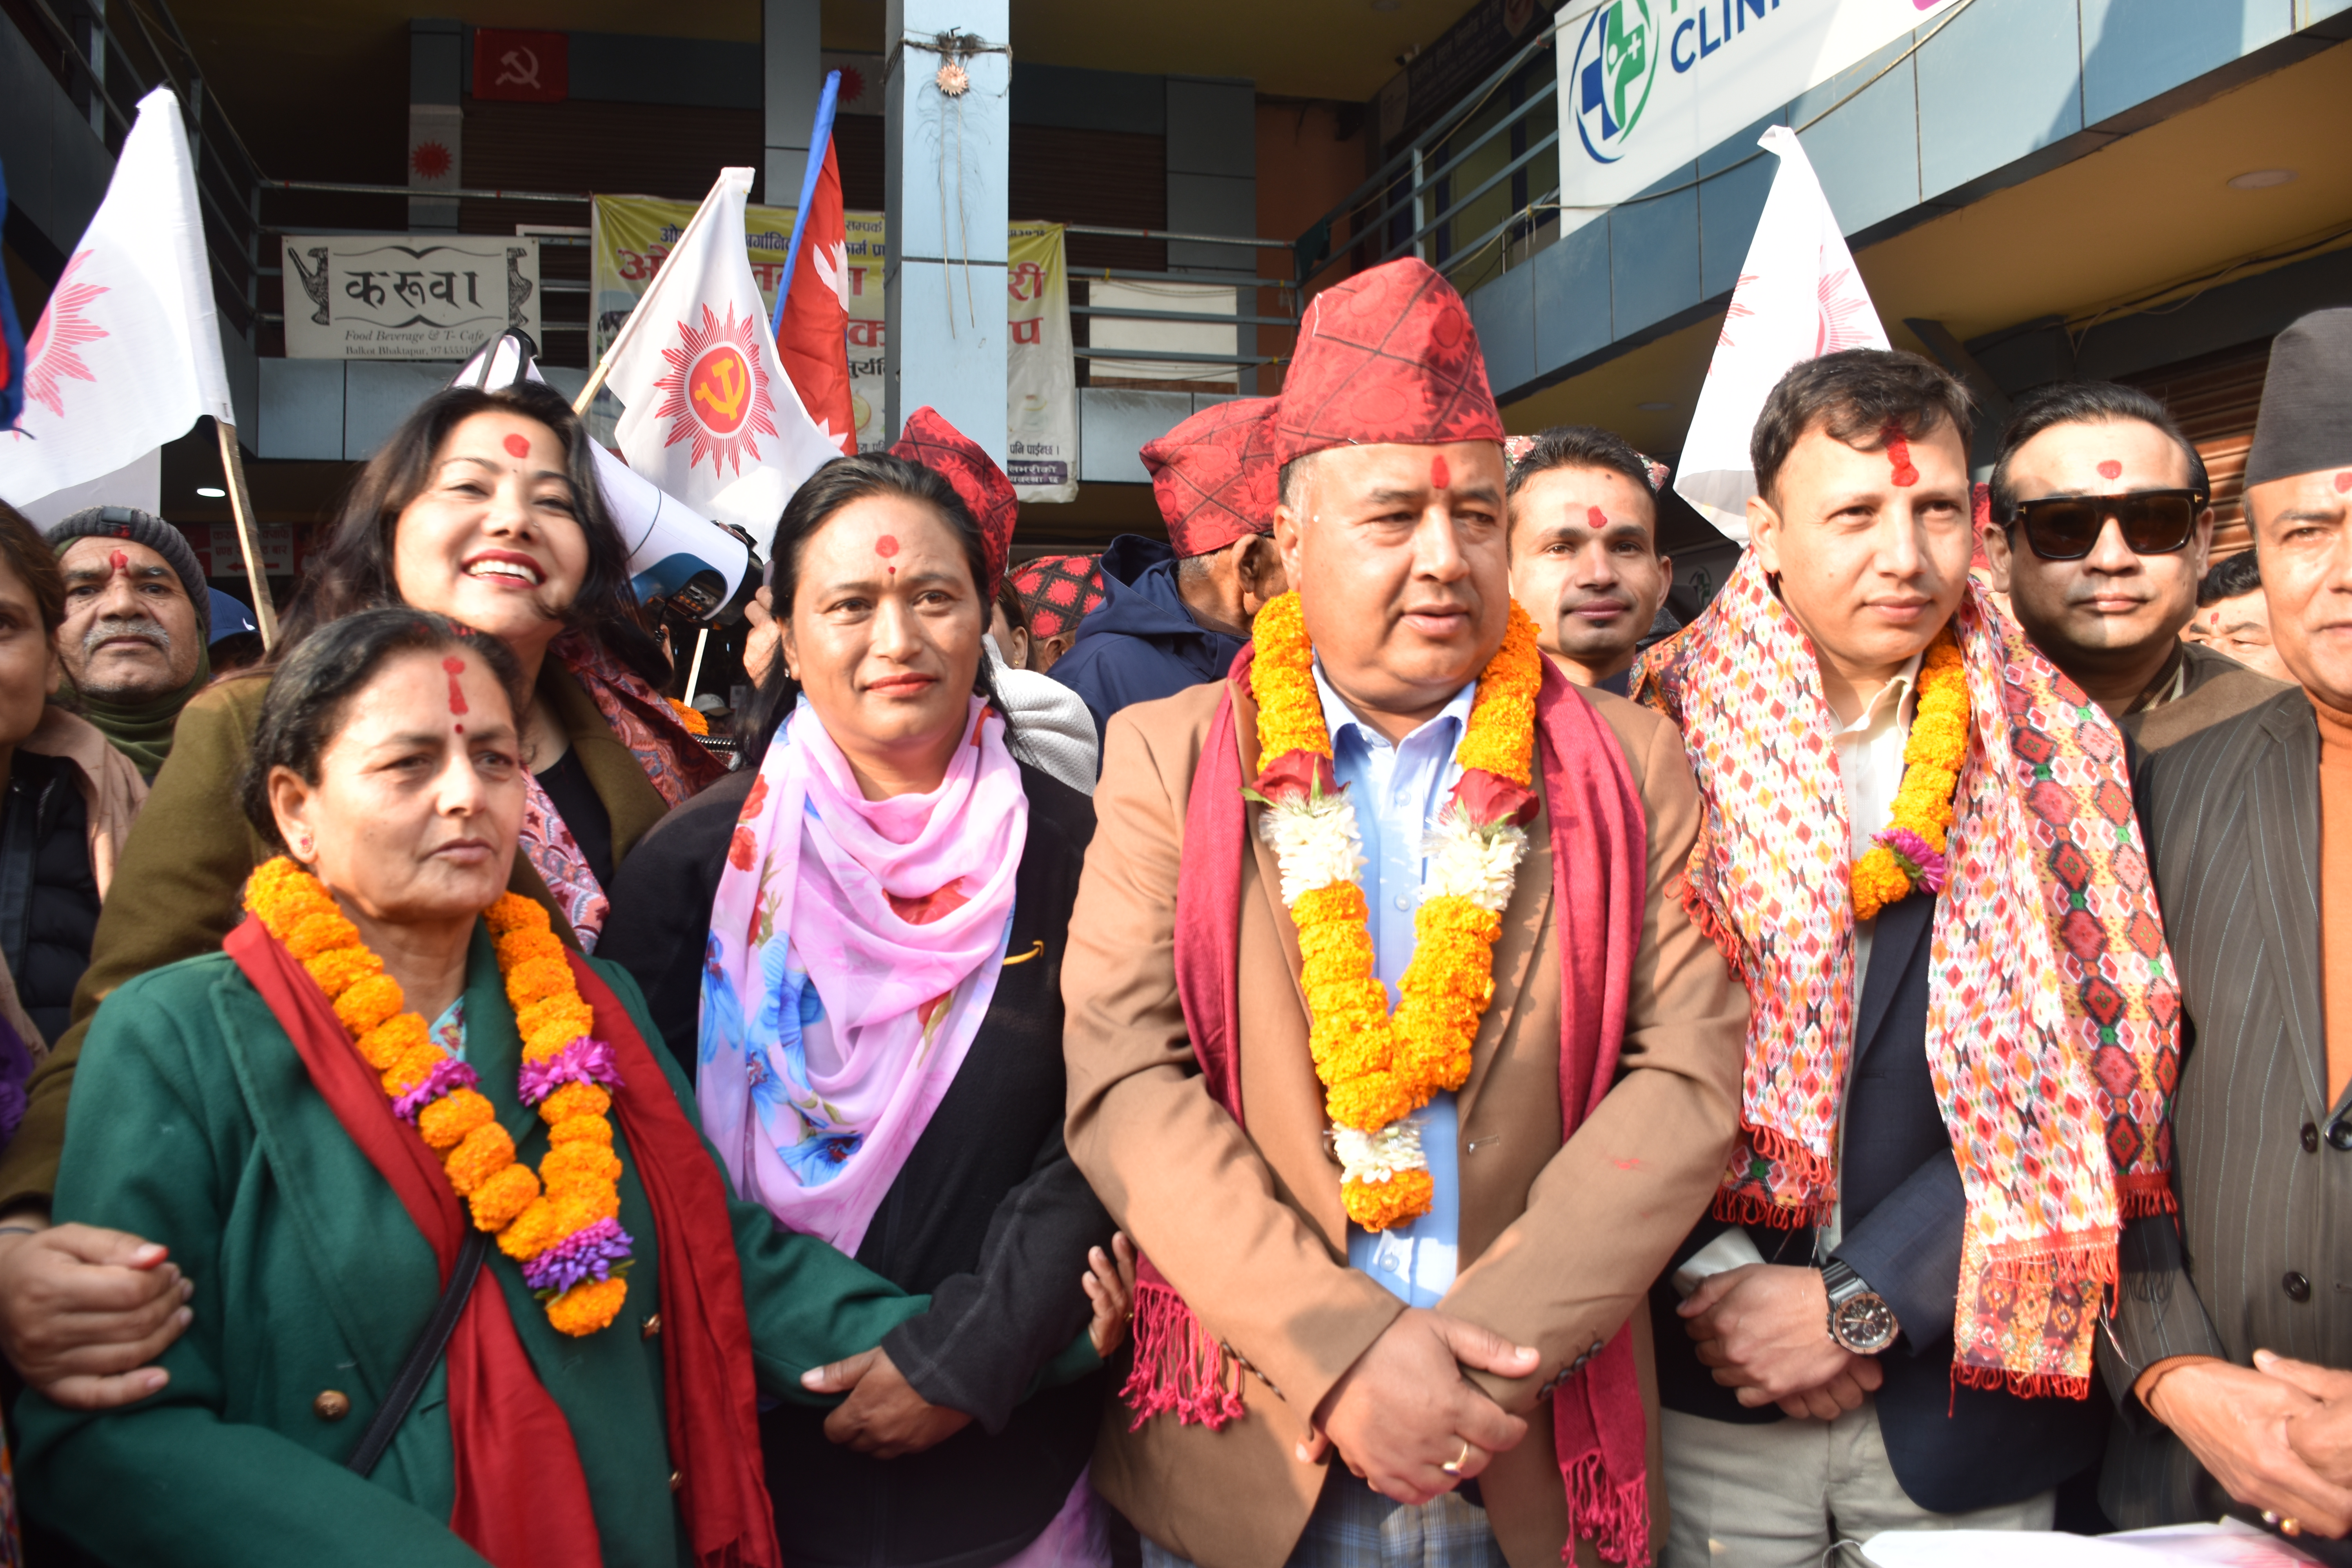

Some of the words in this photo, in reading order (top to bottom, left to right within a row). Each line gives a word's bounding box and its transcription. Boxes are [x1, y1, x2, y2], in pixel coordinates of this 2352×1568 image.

[1671, 0, 1780, 74] CLIN
[345, 330, 372, 341] Food
[376, 330, 424, 344] Beverage
[428, 330, 440, 341] &
[460, 330, 484, 344] Cafe
[346, 346, 375, 356] Balkot
